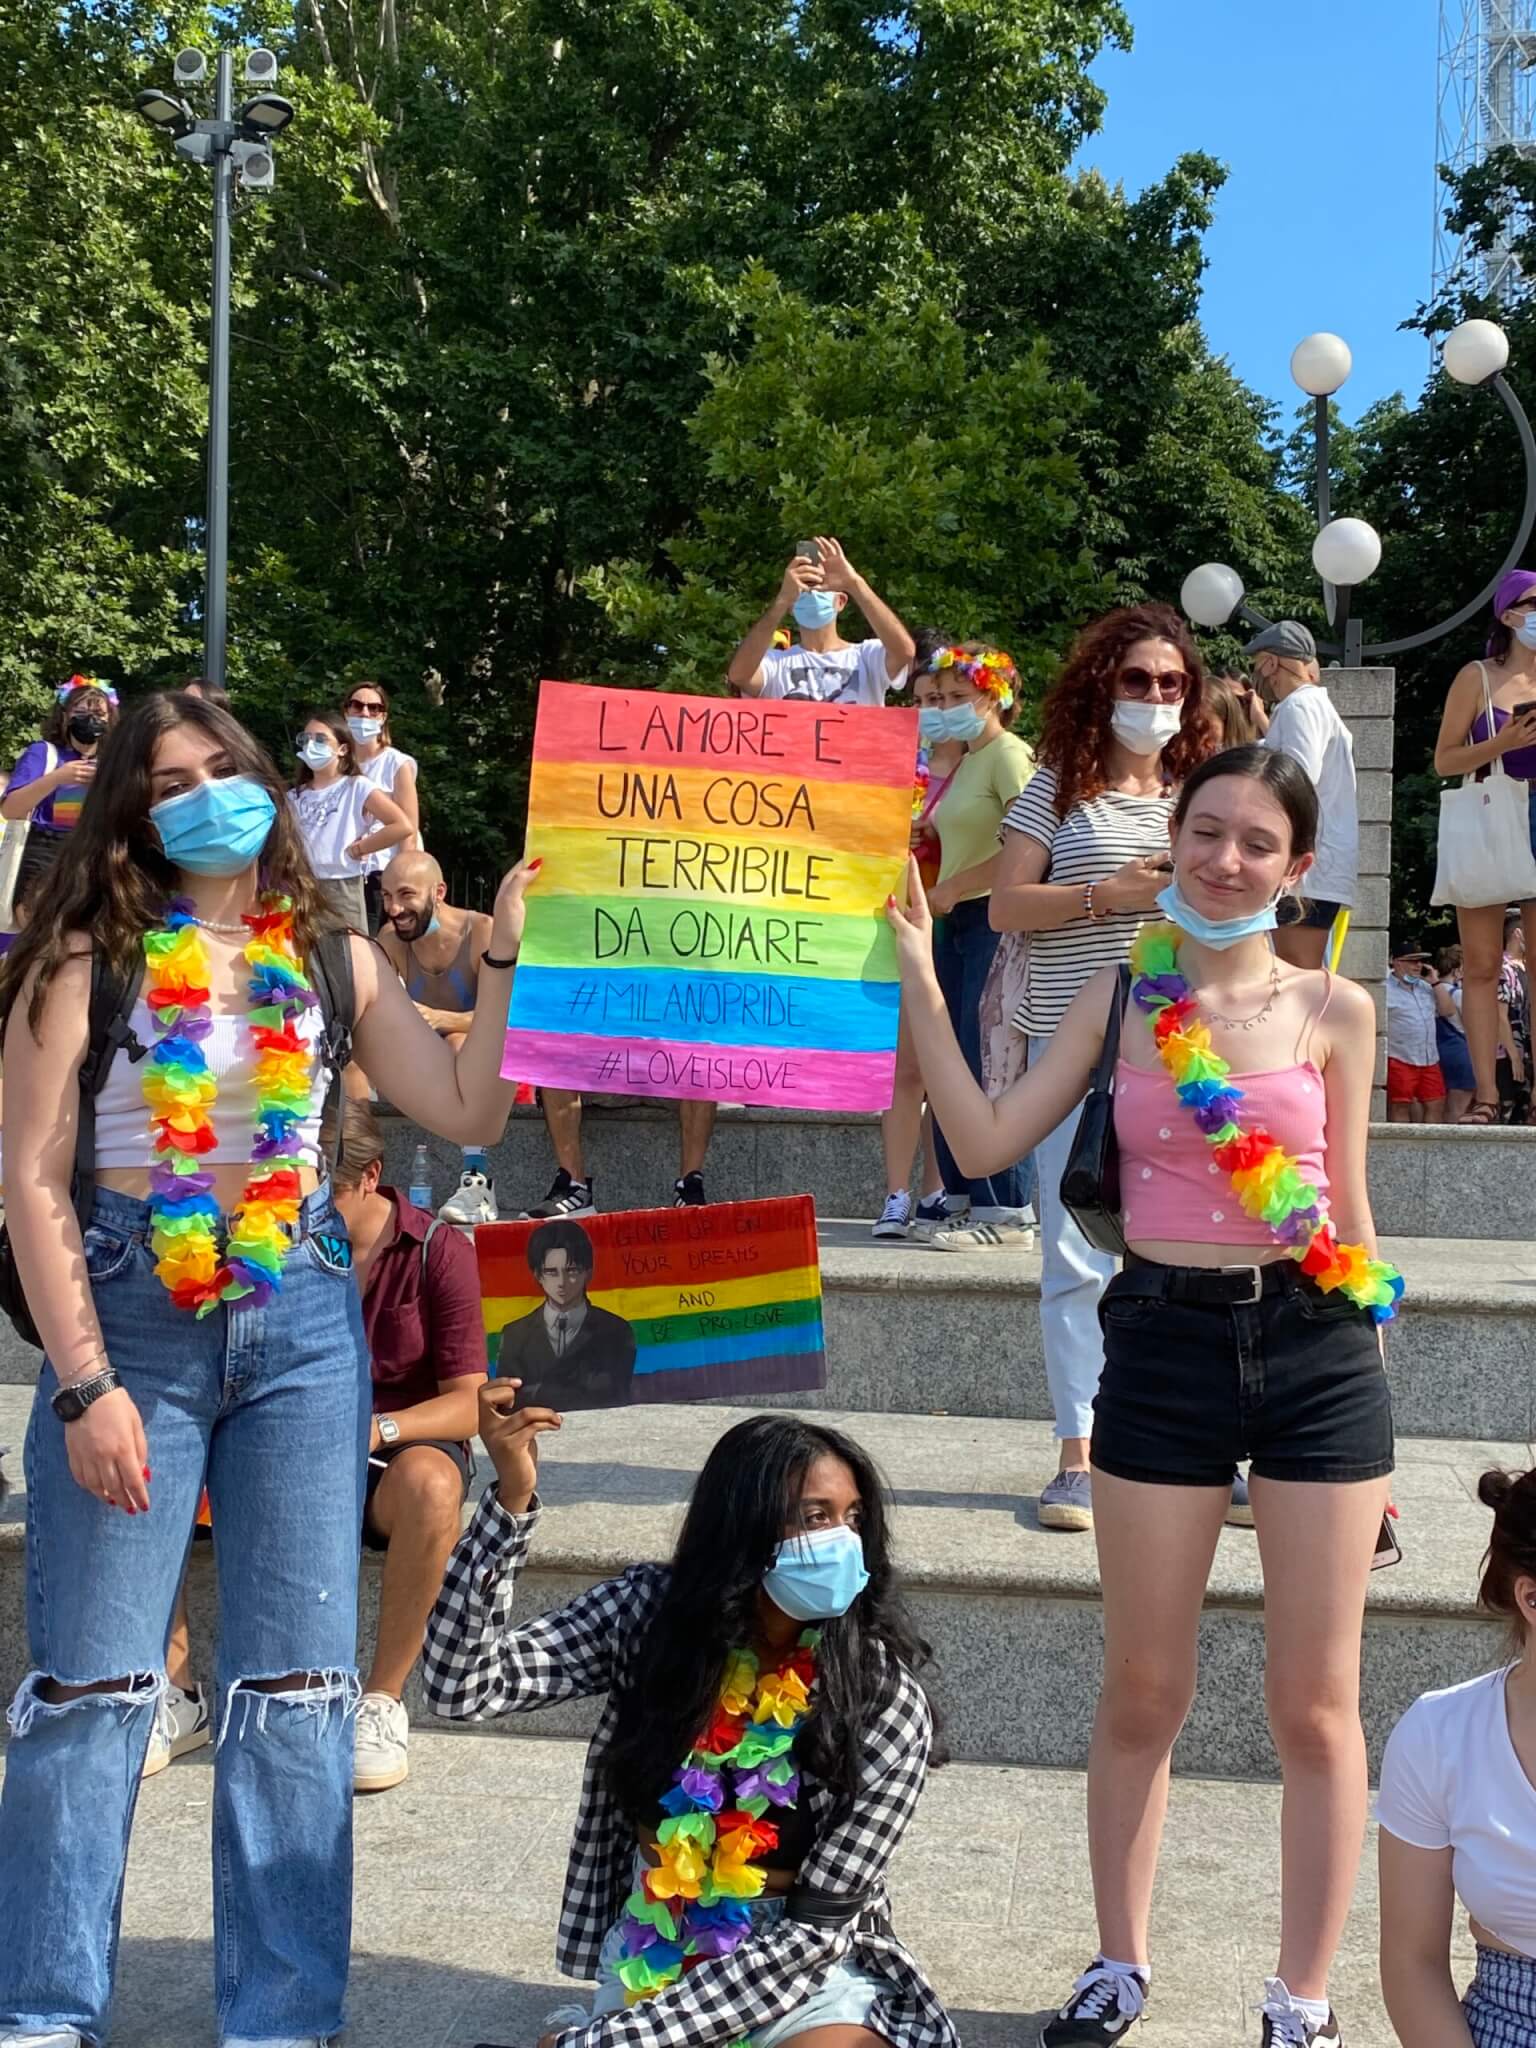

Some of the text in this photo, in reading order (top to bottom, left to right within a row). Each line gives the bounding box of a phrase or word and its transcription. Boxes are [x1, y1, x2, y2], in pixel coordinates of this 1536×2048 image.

[599, 700, 788, 757] L'AMORE
[597, 772, 815, 831] UNA COSA
[606, 836, 834, 901] TERRIBILE
[595, 907, 824, 966] DA ODIARE
[566, 980, 809, 1028] #MILANOPRIDE
[596, 1049, 803, 1091] #LOVEISLOVE
[615, 1223, 670, 1248] GIVE
[687, 1219, 713, 1240] UP
[622, 1253, 673, 1276] YOUR
[678, 1290, 716, 1309] AND
[651, 1321, 673, 1343] BE
